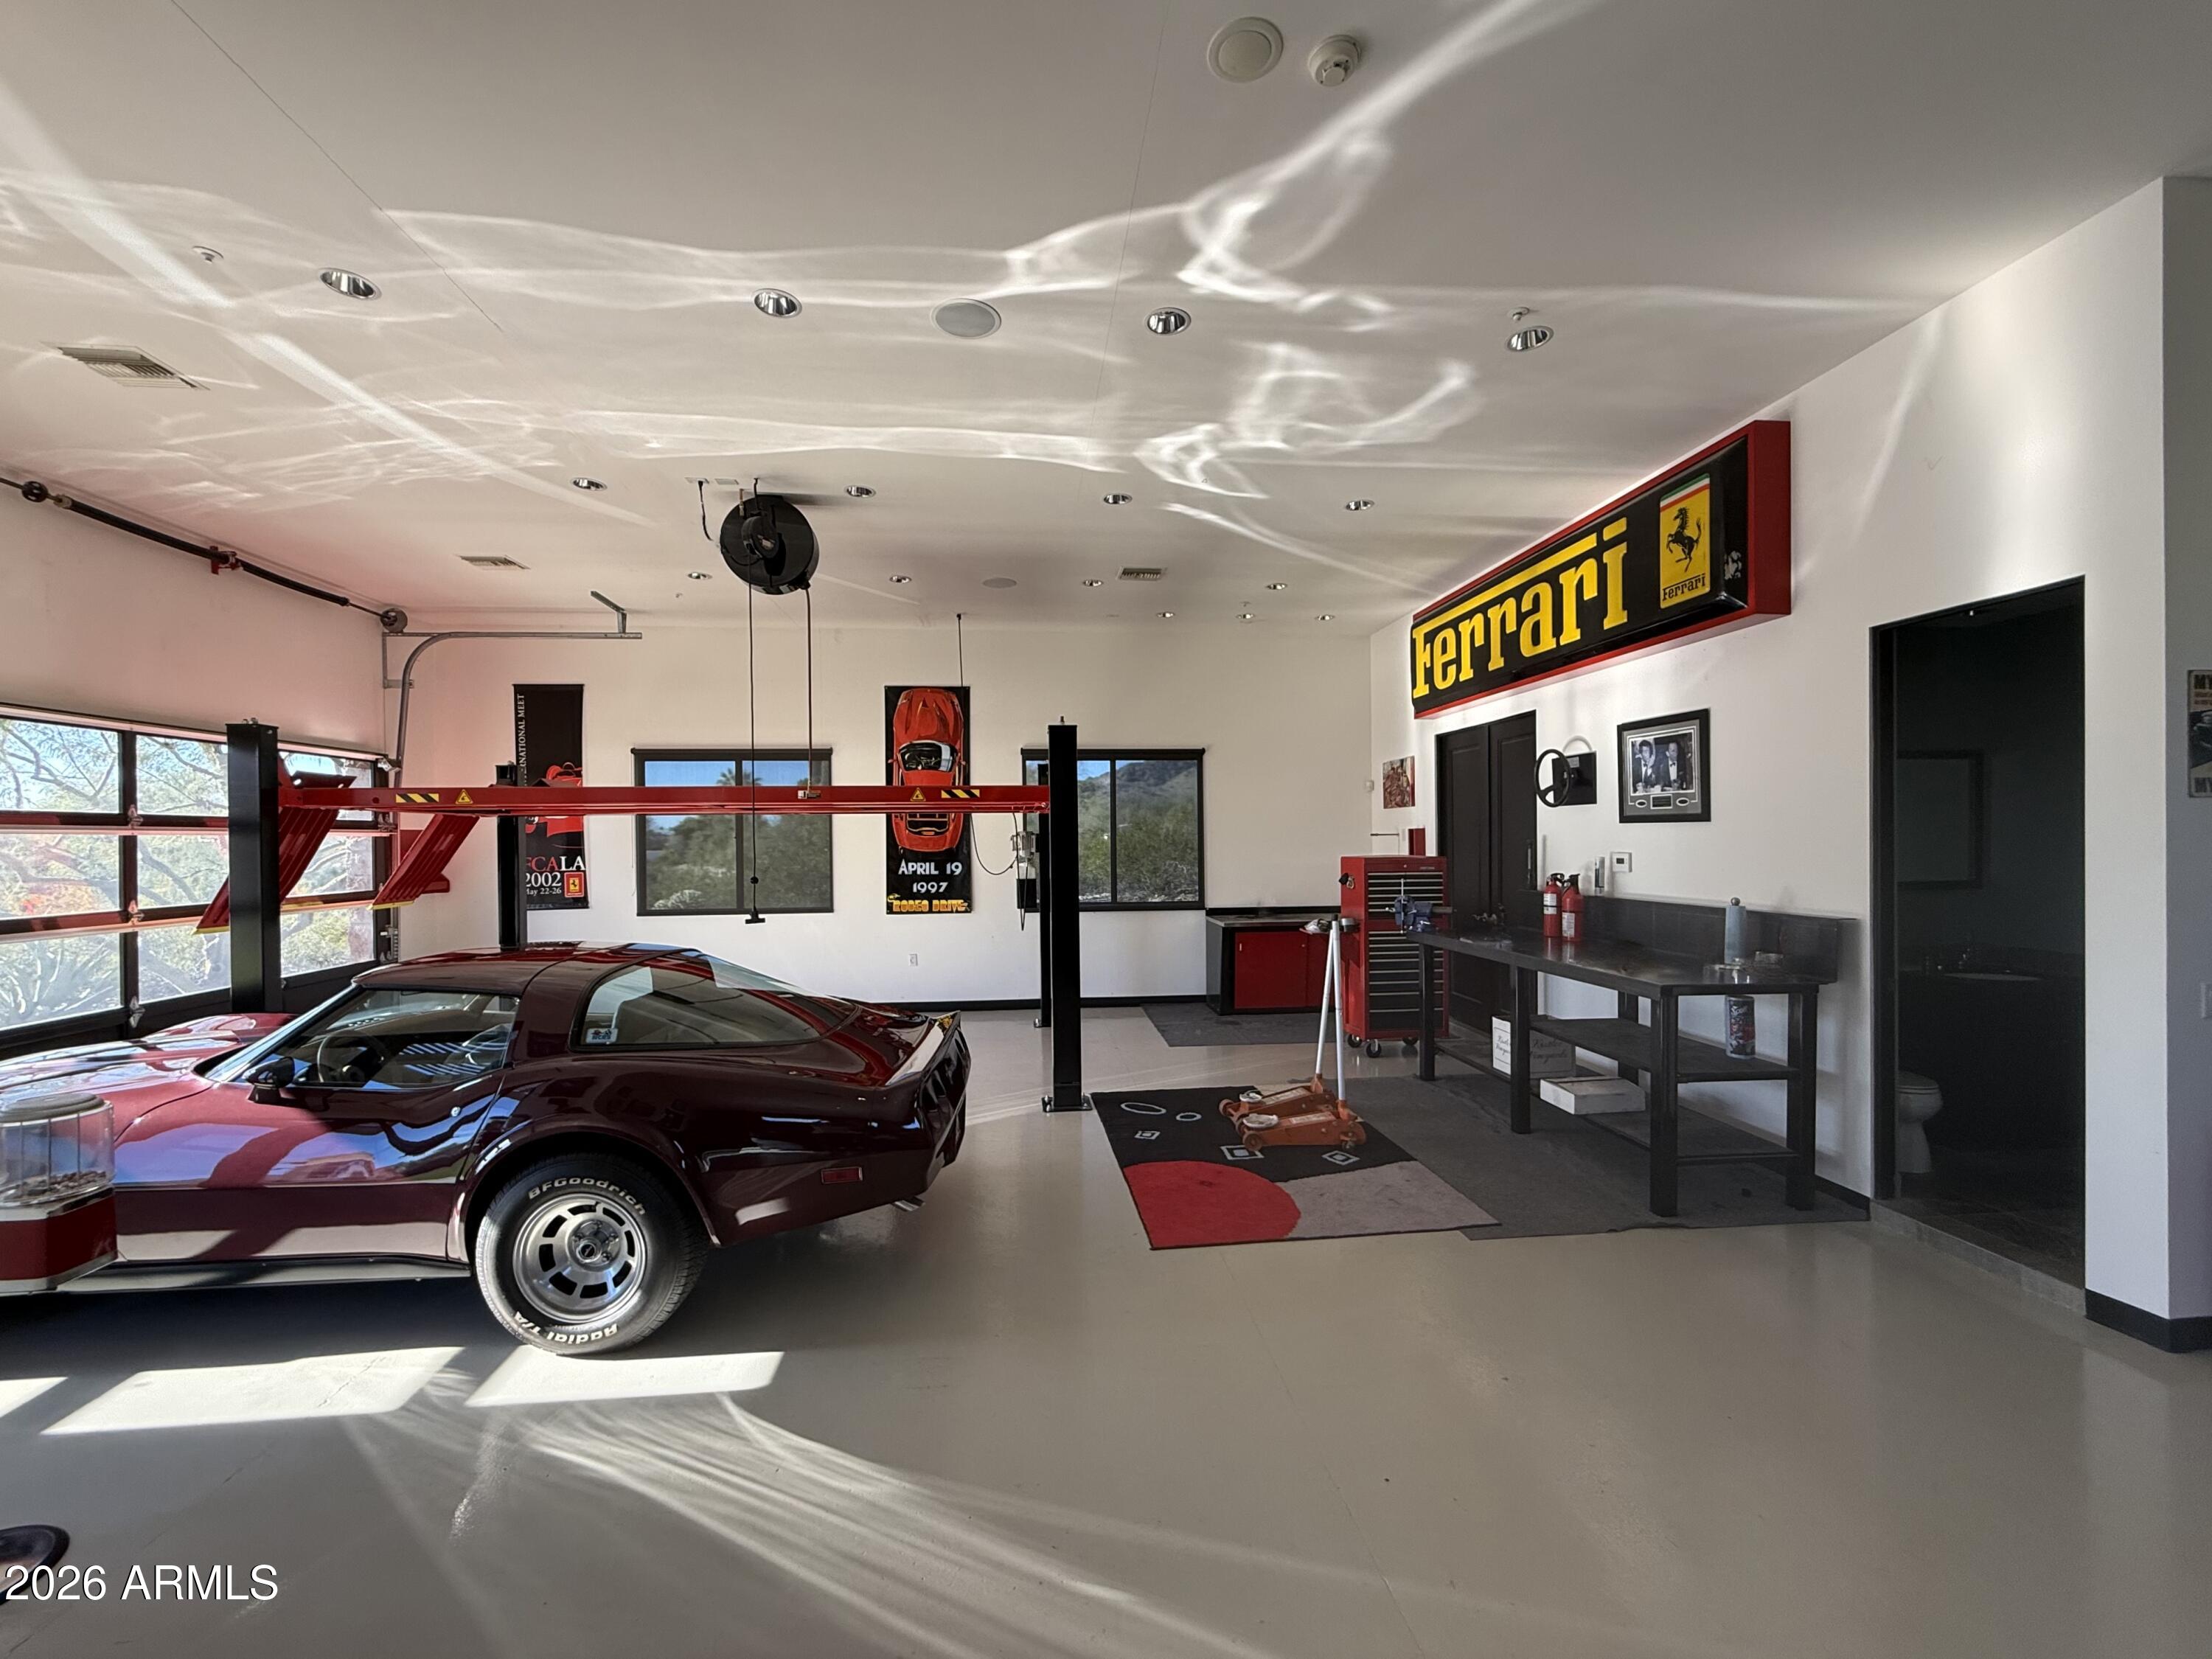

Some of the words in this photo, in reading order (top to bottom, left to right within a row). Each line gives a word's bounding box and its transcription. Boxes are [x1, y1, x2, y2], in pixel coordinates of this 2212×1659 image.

[1663, 573, 1705, 601] Ferrari
[1412, 517, 1627, 698] Ferrari
[898, 858, 939, 874] APRIL
[946, 862, 962, 875] 19
[913, 882, 948, 893] 1997
[891, 897, 929, 912] RODEO
[932, 900, 967, 913] DRIVE
[528, 1178, 646, 1215] BFGoodrich
[546, 1324, 618, 1344] Radial
